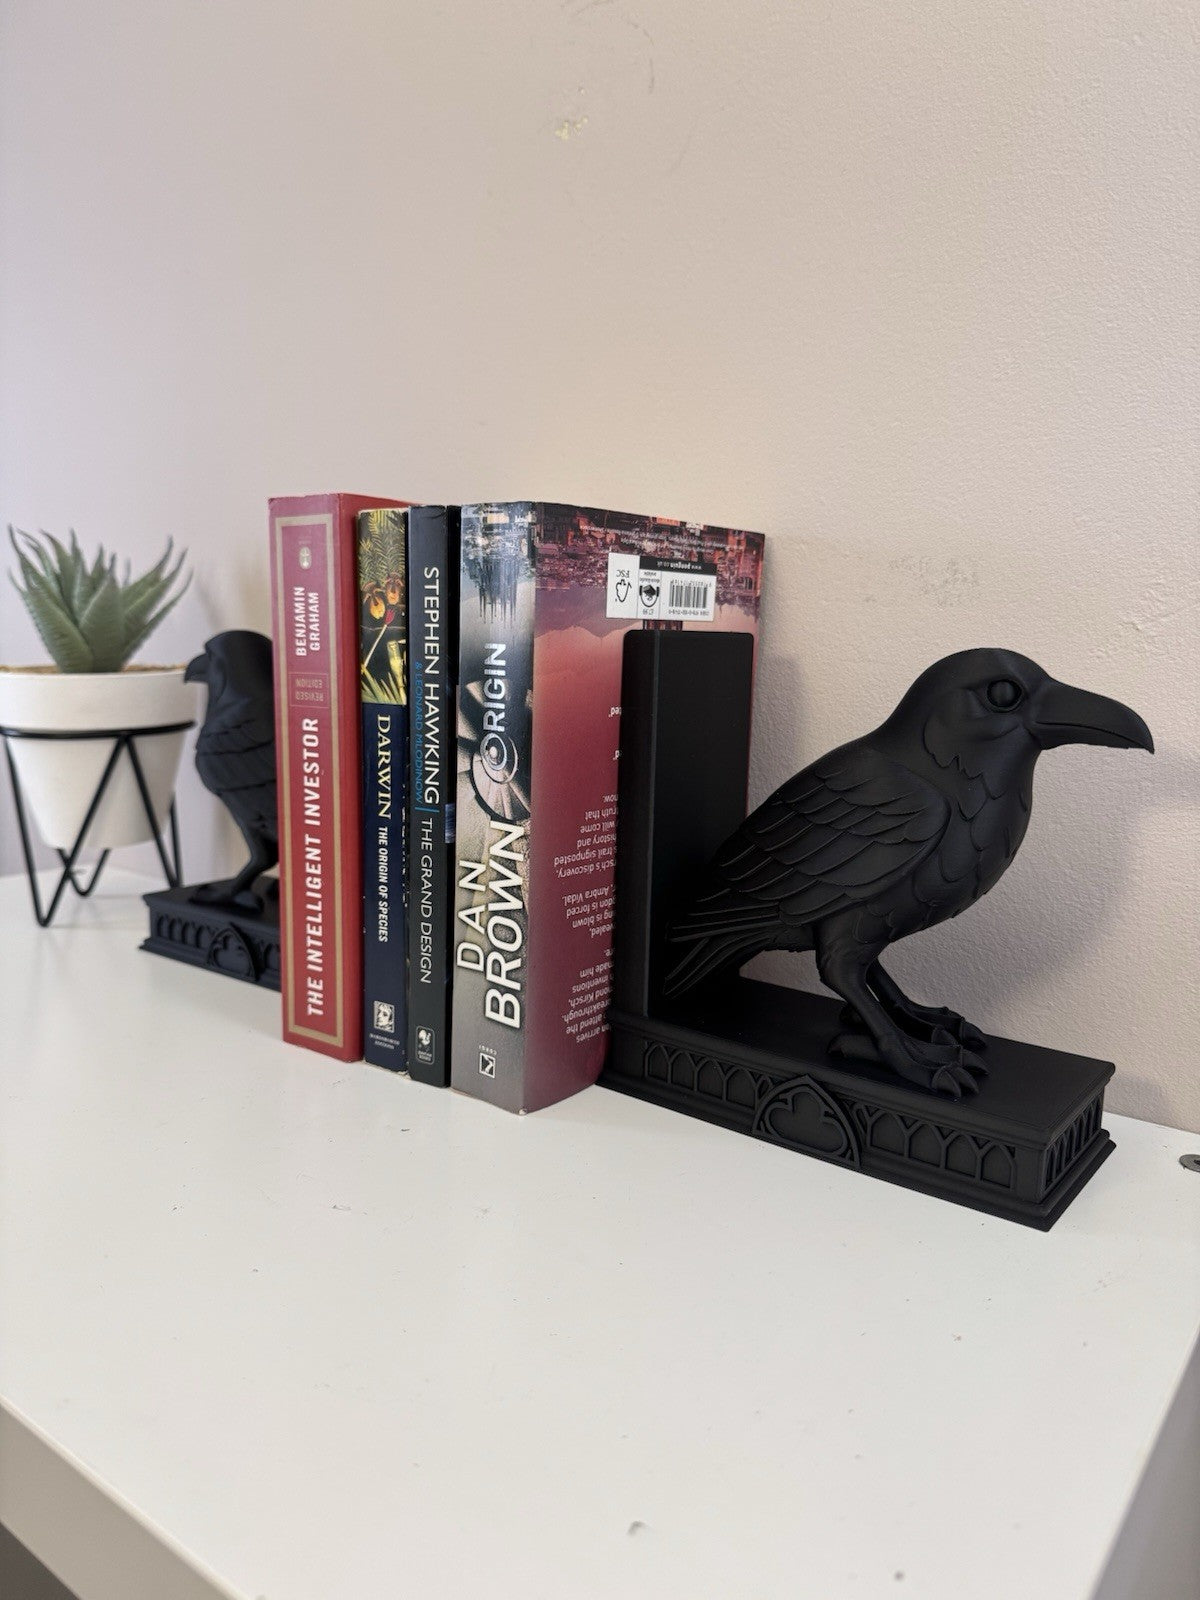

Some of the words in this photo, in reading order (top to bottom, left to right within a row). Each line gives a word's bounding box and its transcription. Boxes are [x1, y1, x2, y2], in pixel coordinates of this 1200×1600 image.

[616, 569, 630, 578] FSC
[294, 587, 307, 656] BENJAMIN
[308, 592, 321, 651] GRAHAM
[424, 567, 440, 675] STEPHEN
[415, 661, 423, 670] &
[296, 678, 323, 688] EDITION
[414, 674, 423, 731] LEONARD
[479, 642, 507, 771] ORIGIN
[424, 684, 440, 805] HAWKING
[302, 718, 321, 826] INVESTOR
[377, 714, 391, 819] DARWIN
[413, 733, 423, 804] MLODINOW
[585, 809, 600, 821] that
[421, 818, 433, 851] THE
[580, 824, 600, 834] come
[602, 821, 615, 832] will
[378, 826, 388, 845] THE
[577, 837, 591, 848] and
[554, 850, 596, 867] signposted
[598, 848, 612, 858] trail
[378, 847, 388, 882] ORIGIN
[378, 883, 388, 899] OF
[420, 855, 433, 918] GRAND
[585, 887, 609, 899] Ambra
[304, 833, 323, 972] INTELLIGENT
[566, 903, 590, 919] forced
[591, 901, 598, 910] is
[378, 900, 388, 943] SPECIES
[457, 860, 486, 972] DAN
[484, 820, 525, 1029] BROWN
[572, 915, 594, 928] blown
[596, 913, 603, 922] is
[420, 922, 432, 984] DESIGN
[580, 966, 594, 978] him
[572, 976, 608, 993] inventions
[307, 976, 324, 1017] THE
[568, 991, 594, 1008] Kirsch,
[566, 1023, 578, 1035] the
[579, 1013, 602, 1029] attend
[576, 1028, 600, 1043] arrives
